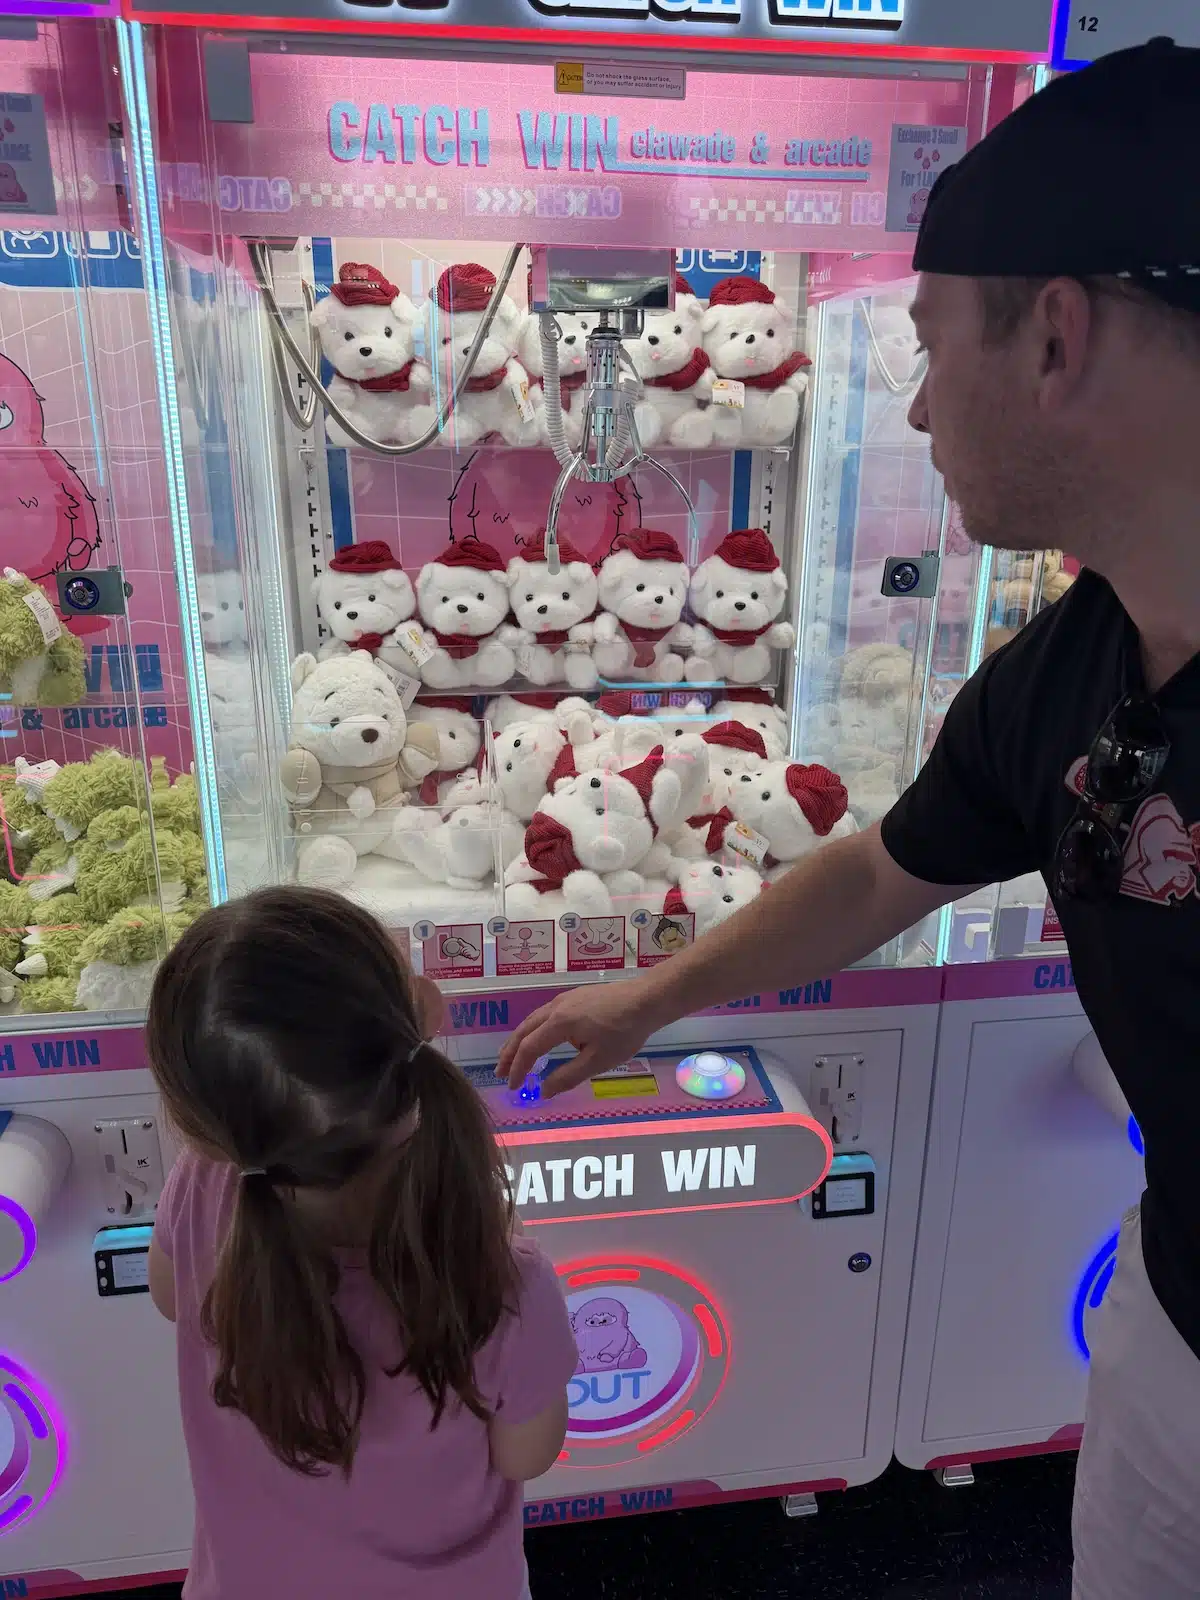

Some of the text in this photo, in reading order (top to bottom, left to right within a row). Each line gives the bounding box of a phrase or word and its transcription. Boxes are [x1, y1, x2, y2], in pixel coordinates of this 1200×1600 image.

[1078, 15, 1099, 32] 12
[327, 101, 872, 174] CATCH WIN clawade & arcade
[493, 922, 505, 933] 2
[564, 918, 576, 928] 3
[634, 913, 647, 924] 4
[420, 925, 428, 937] 1
[449, 1000, 509, 1028] WIN
[31, 1038, 100, 1069] WIN
[661, 1144, 757, 1193] WIN
[524, 1488, 673, 1525] CATCH WIN
